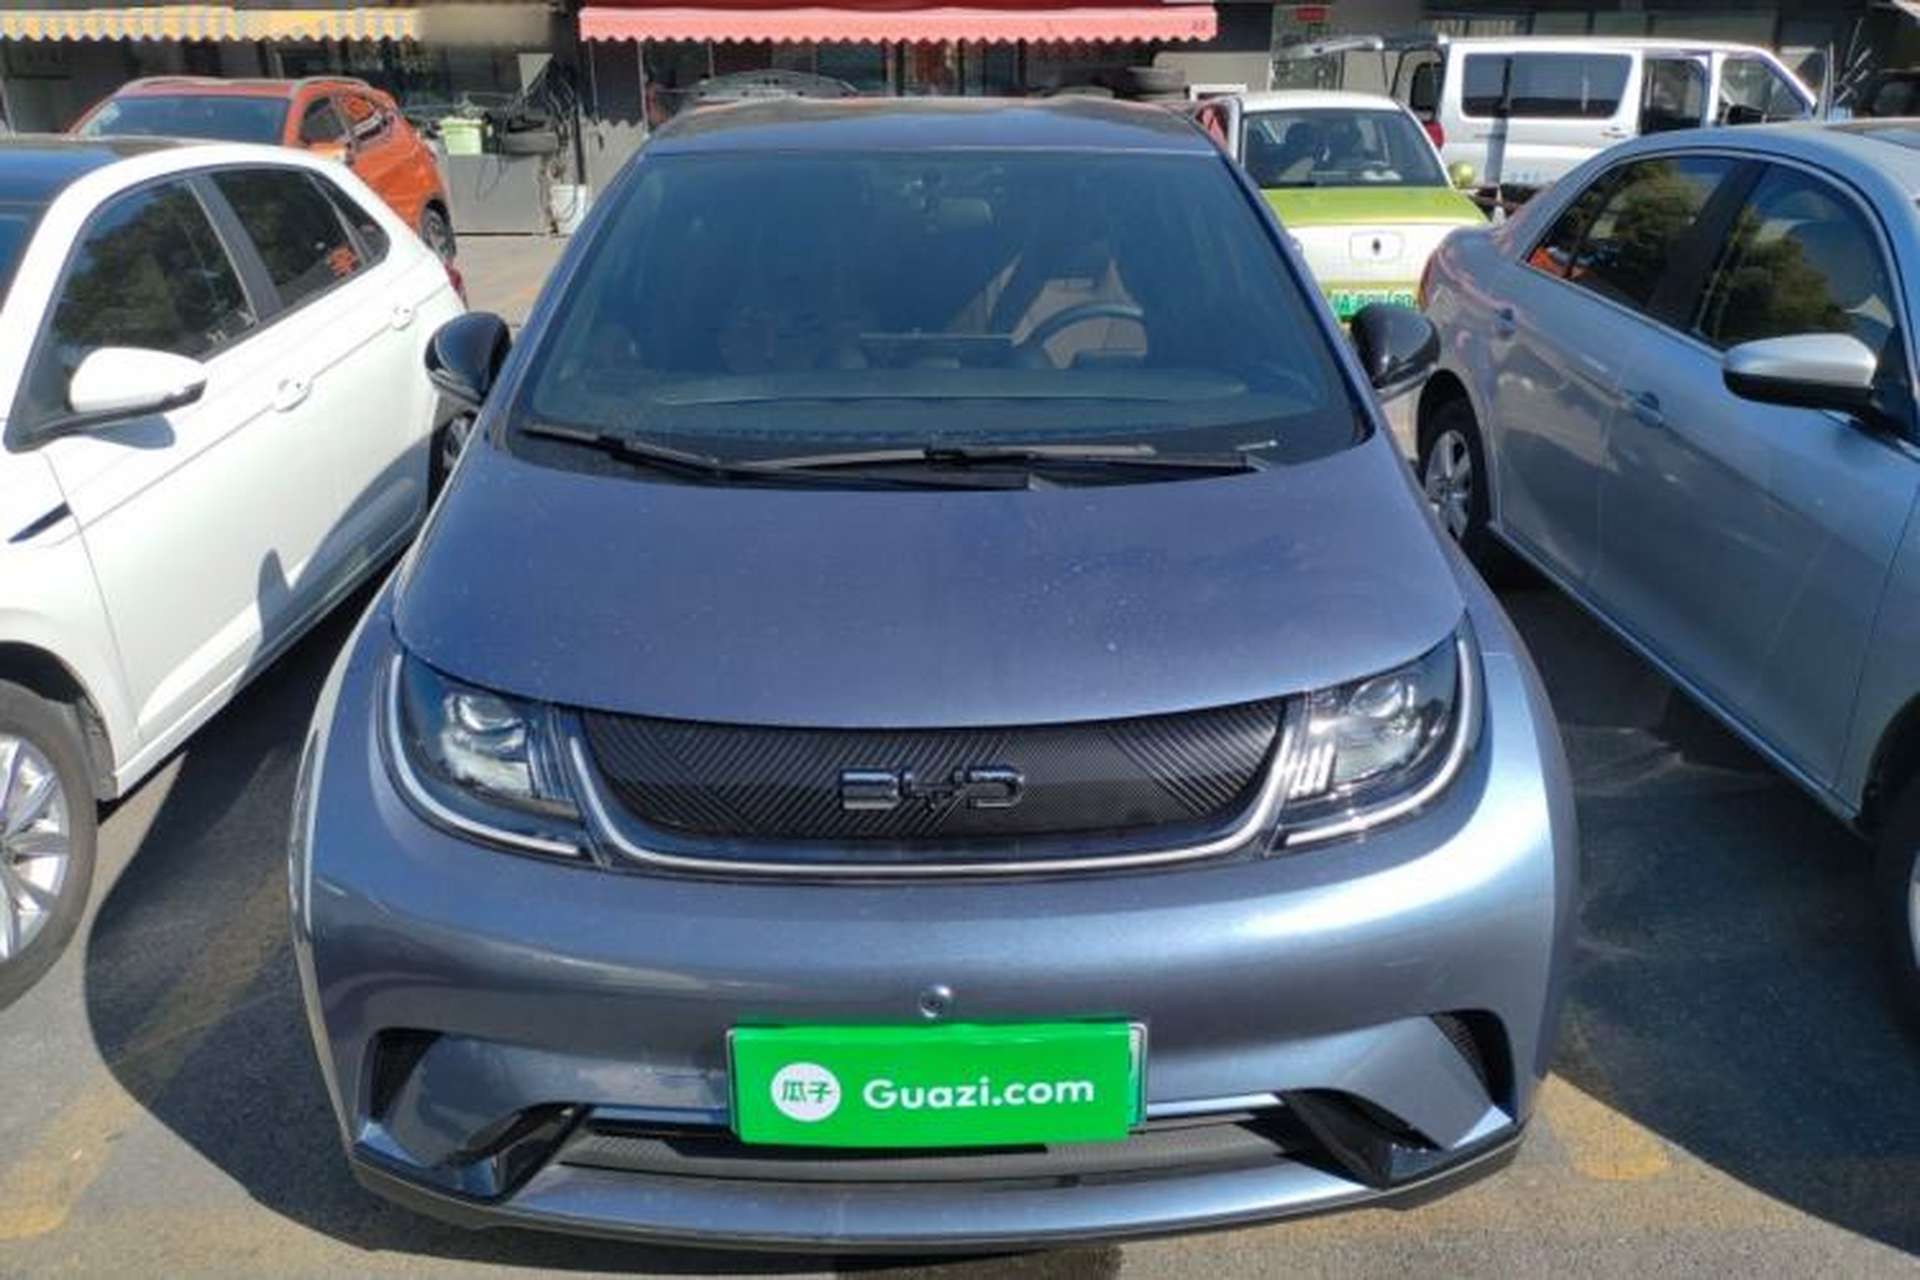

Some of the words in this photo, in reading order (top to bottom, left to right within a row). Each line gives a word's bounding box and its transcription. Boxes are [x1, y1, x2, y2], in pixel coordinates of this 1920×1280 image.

[840, 767, 1025, 812] BYD
[782, 1079, 833, 1104] 瓜子
[863, 1076, 1094, 1109] Guazi.com
